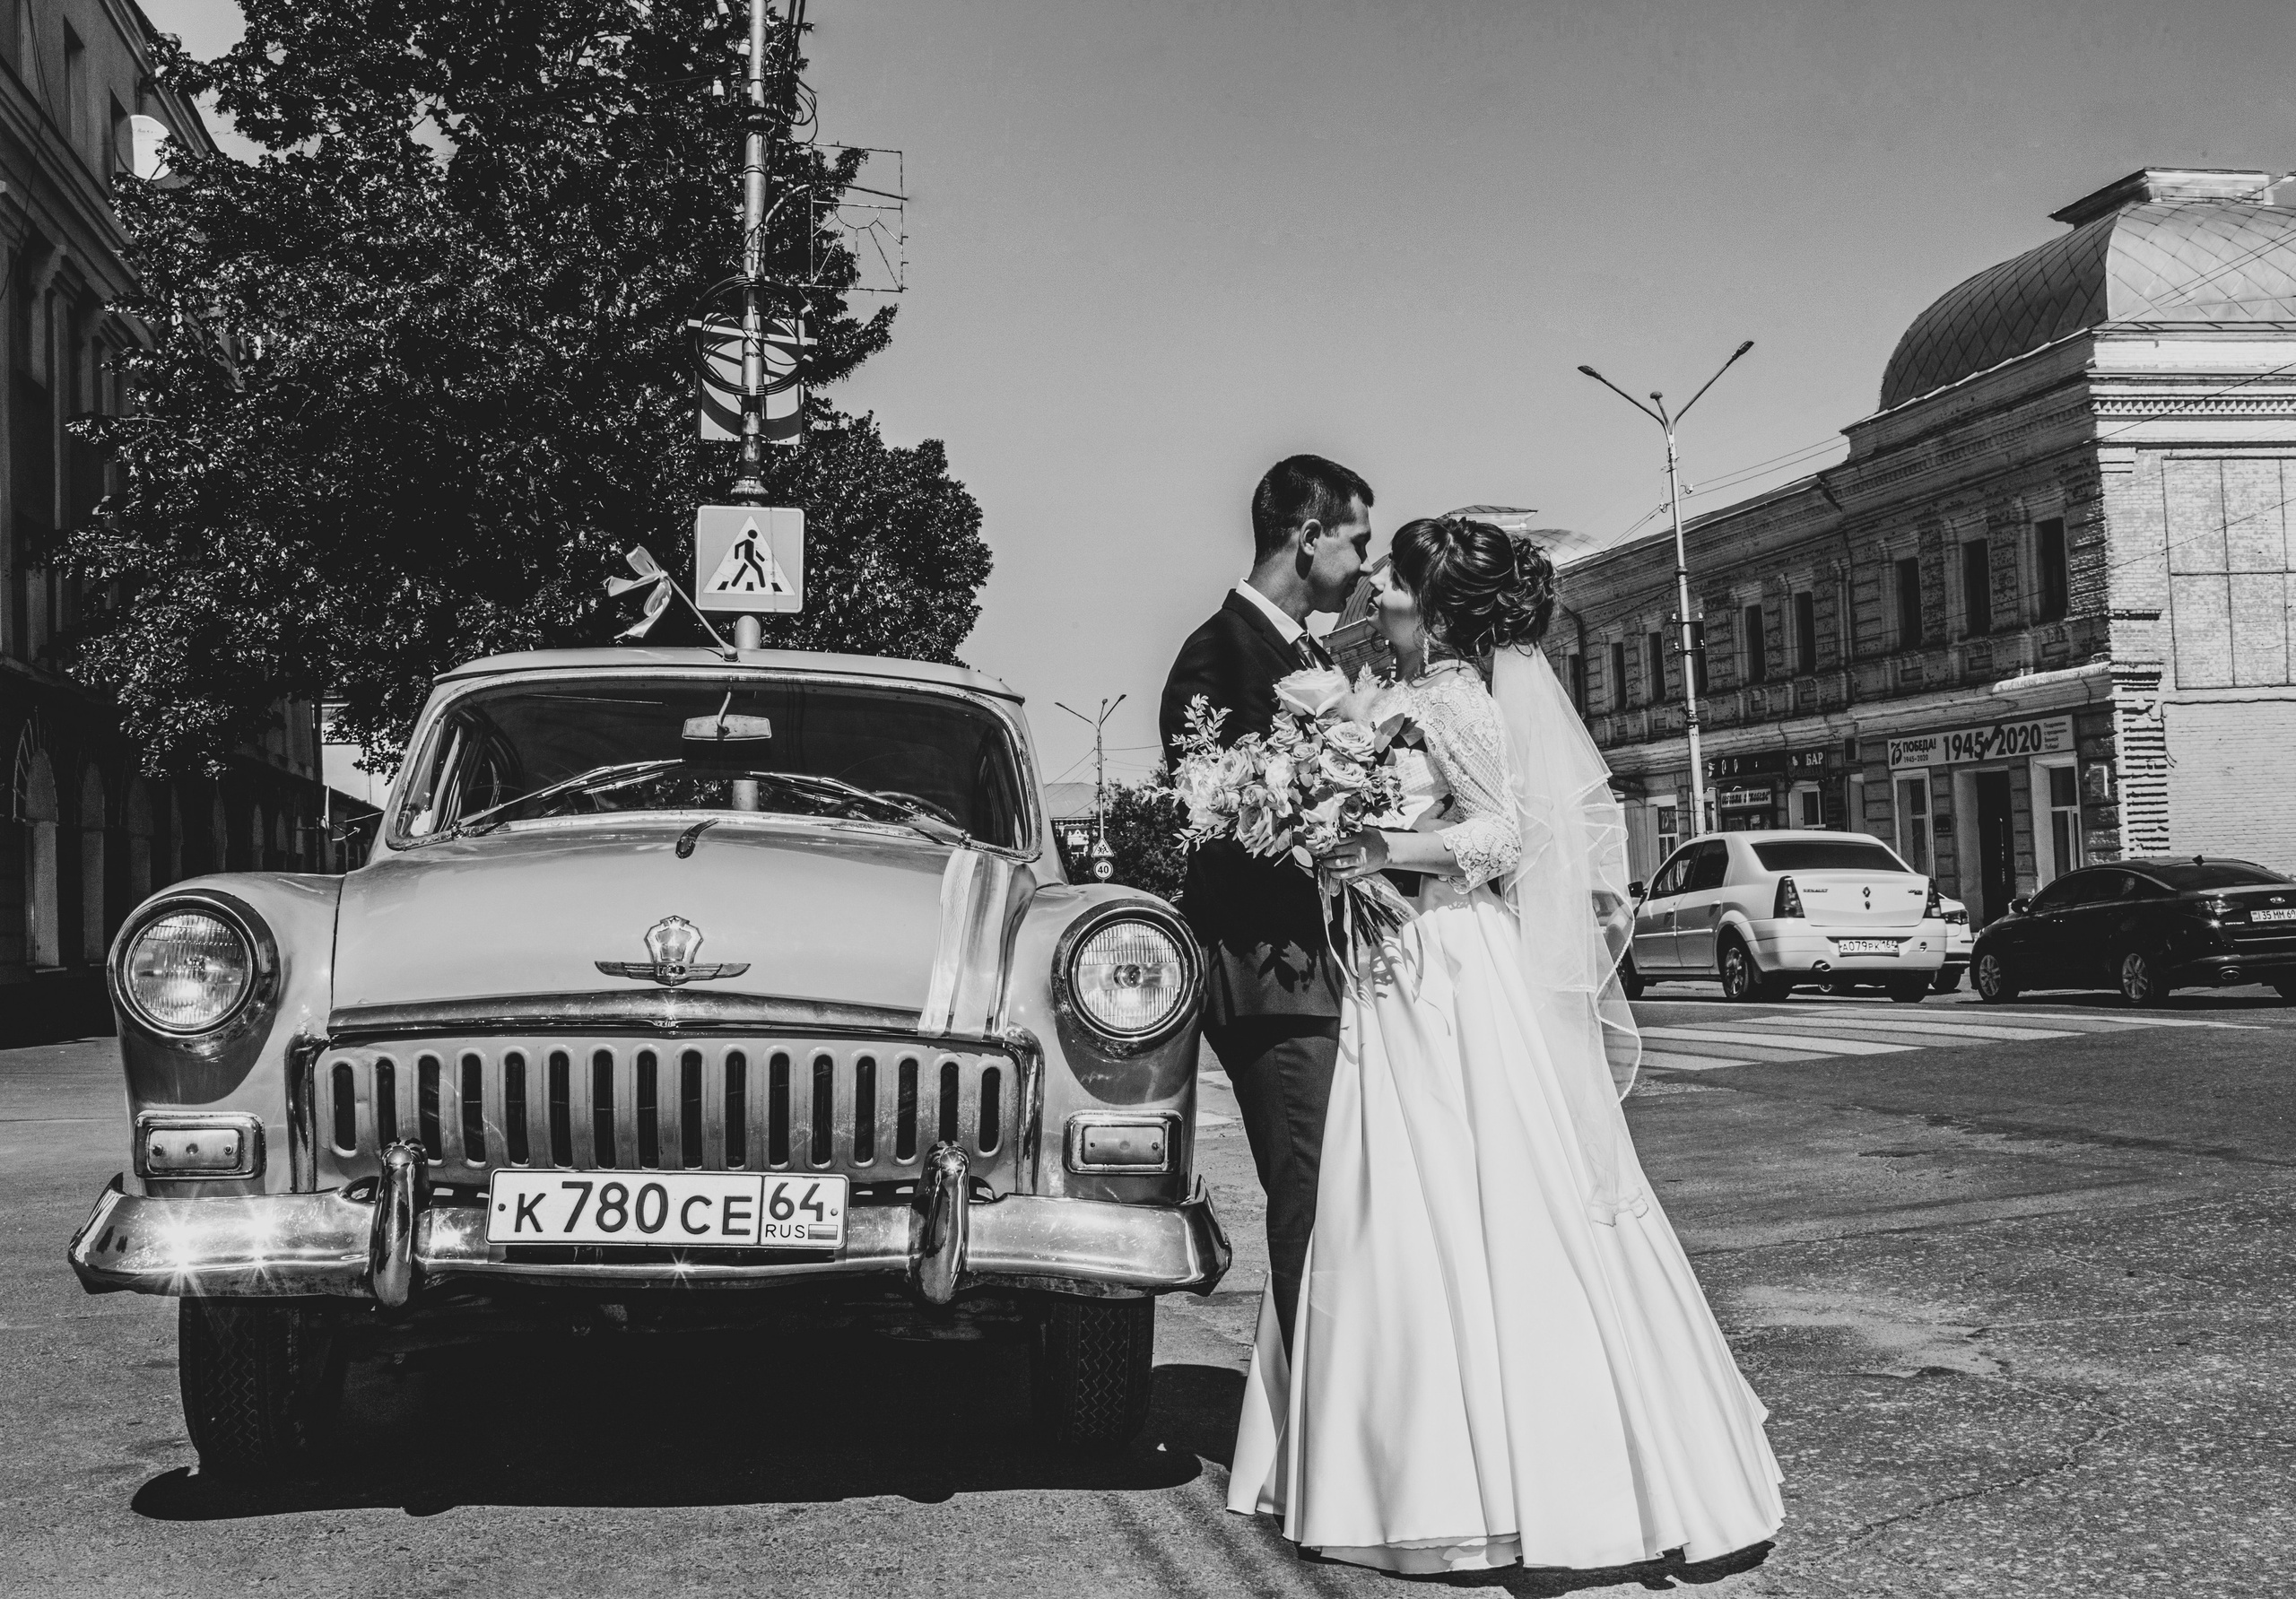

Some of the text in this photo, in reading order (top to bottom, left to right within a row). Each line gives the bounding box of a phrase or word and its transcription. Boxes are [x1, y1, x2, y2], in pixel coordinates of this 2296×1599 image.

[1902, 738, 1936, 753] ПОБЕДА!
[1943, 723, 2041, 761] 1945 2020
[1805, 752, 1824, 766] БАР
[1098, 865, 1109, 873] 40
[2261, 910, 2272, 920] 35
[2273, 910, 2285, 919] MM
[769, 1182, 824, 1221] 64
[765, 1224, 805, 1238] RUS
